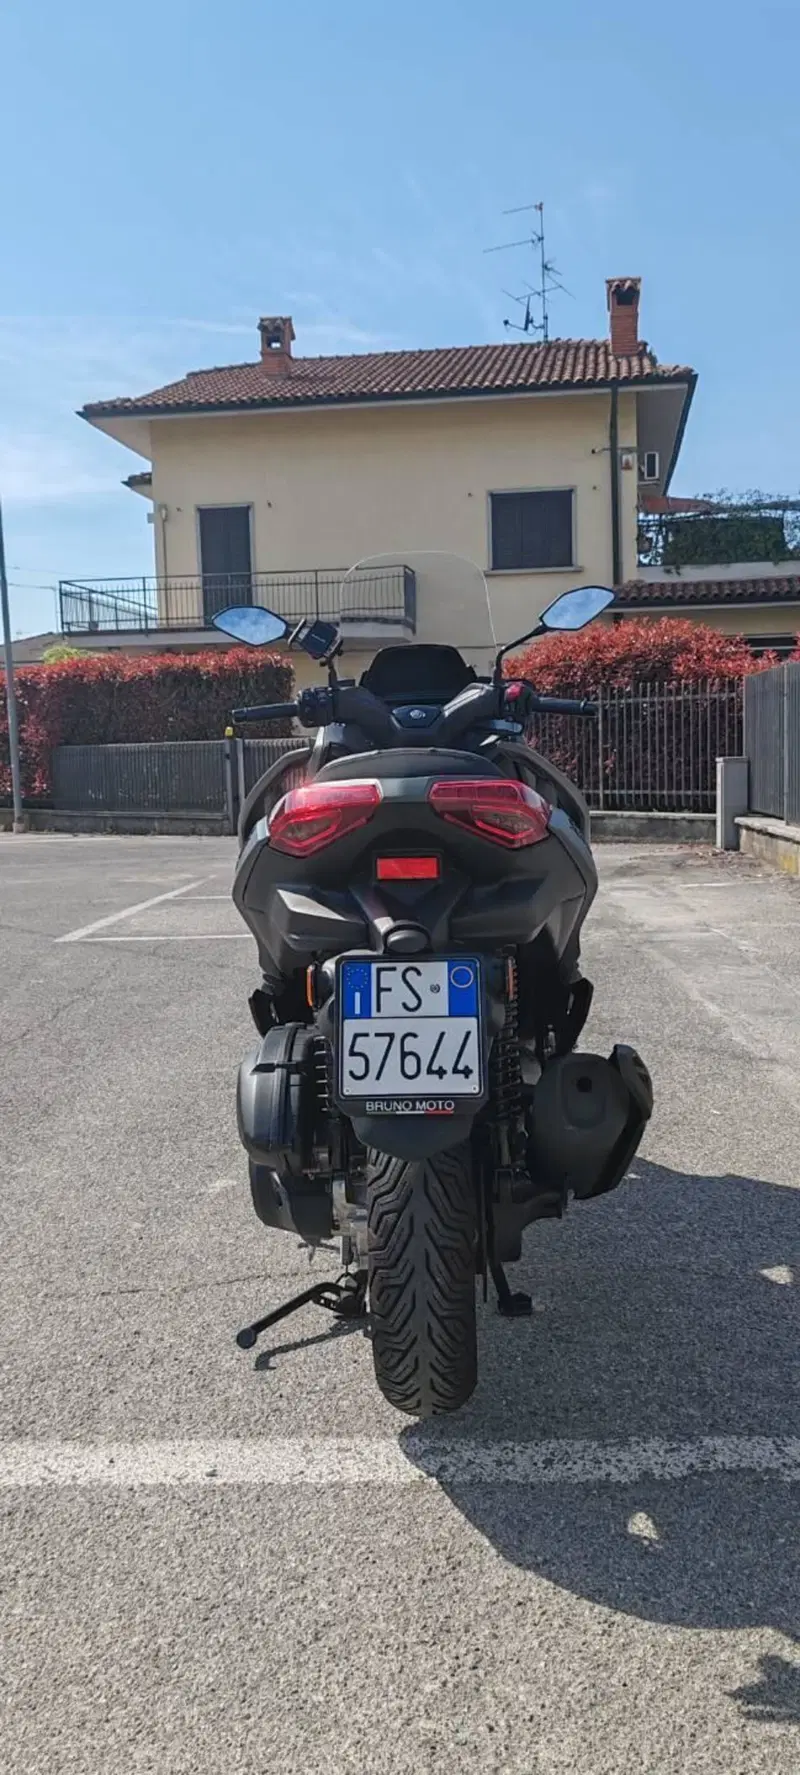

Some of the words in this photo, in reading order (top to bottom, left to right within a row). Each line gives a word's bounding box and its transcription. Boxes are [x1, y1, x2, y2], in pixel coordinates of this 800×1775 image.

[354, 991, 361, 1015] I
[375, 966, 422, 1013] FS
[348, 1030, 473, 1081] 57644
[365, 1100, 412, 1111] BRUNO
[415, 1100, 455, 1110] MOTO
